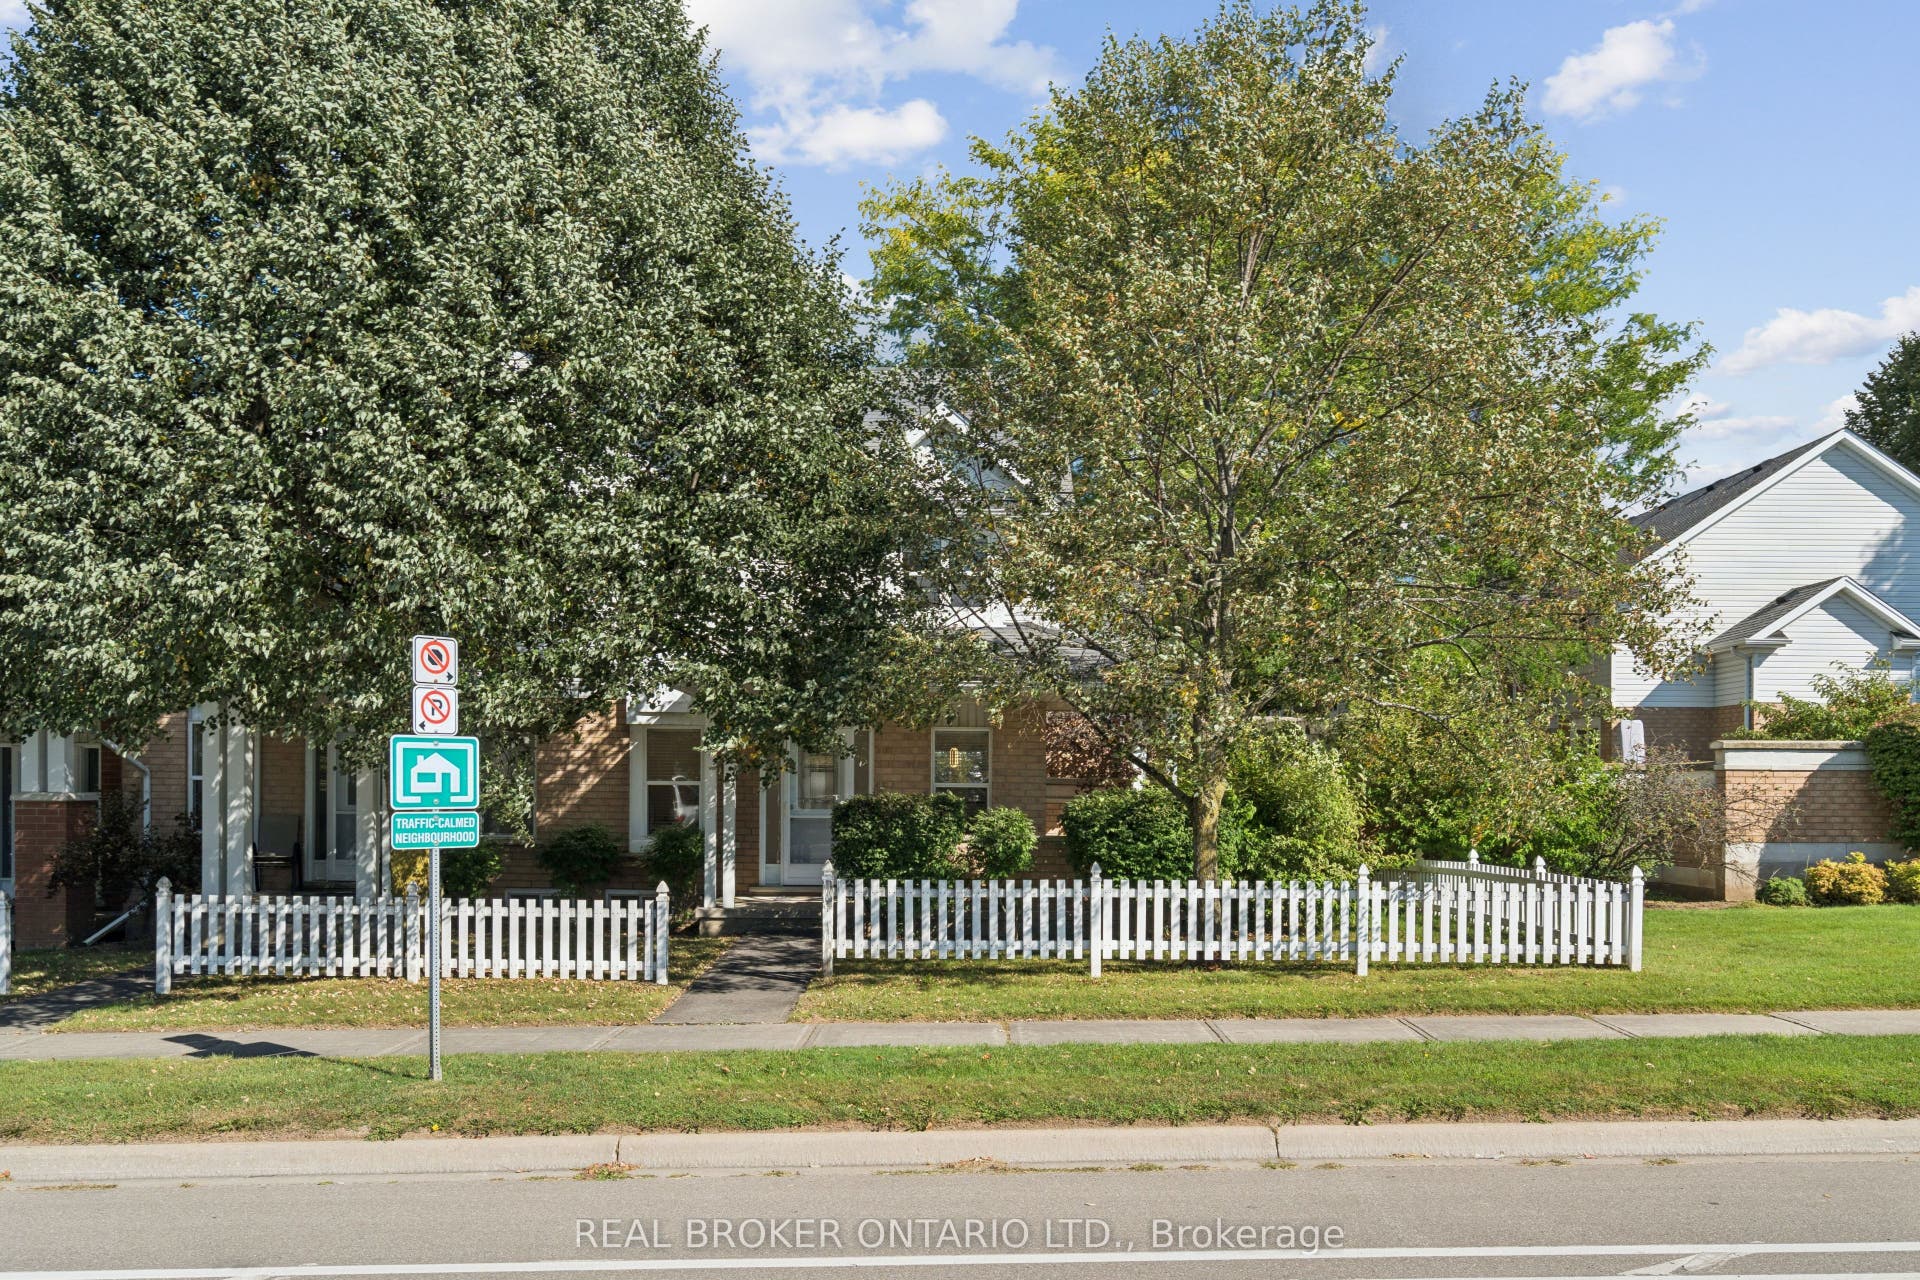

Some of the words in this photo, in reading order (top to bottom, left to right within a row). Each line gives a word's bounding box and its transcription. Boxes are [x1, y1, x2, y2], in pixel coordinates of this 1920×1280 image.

[431, 699, 442, 716] P
[395, 817, 475, 829] TRAFFIC-CALMED
[395, 831, 475, 844] NEIGHBOURHOOD
